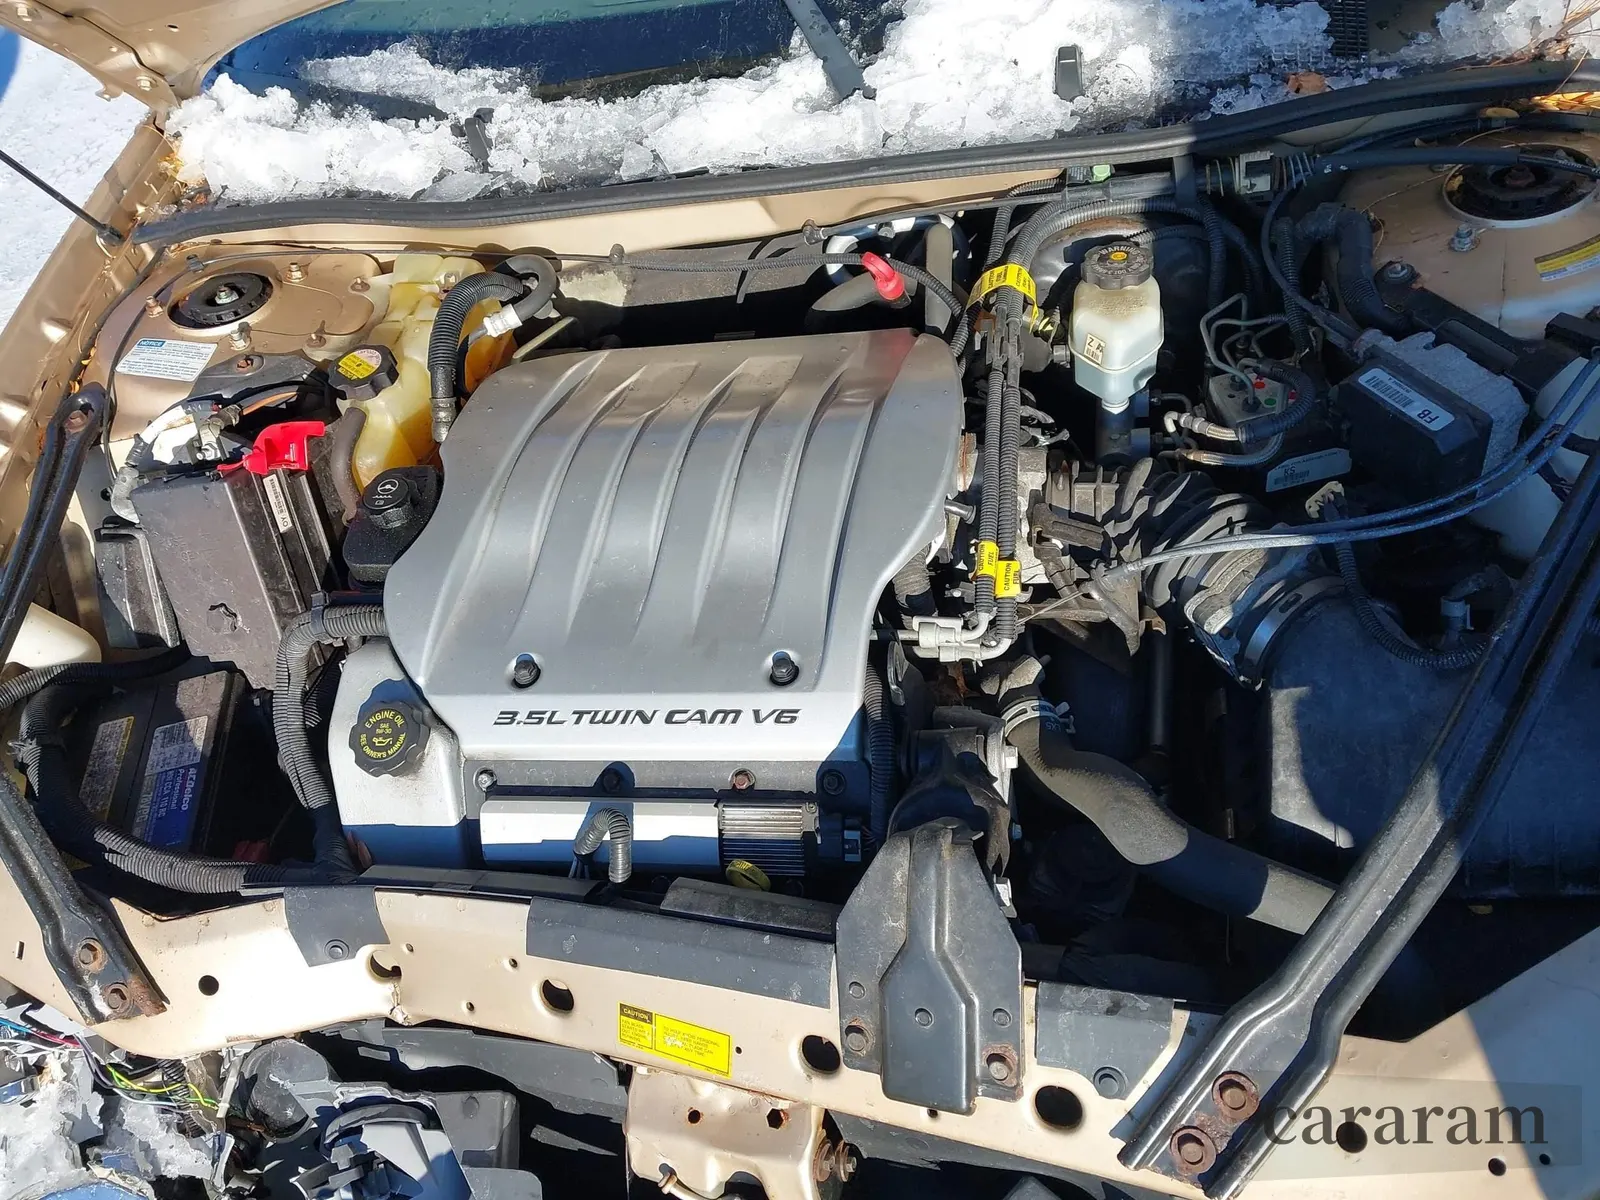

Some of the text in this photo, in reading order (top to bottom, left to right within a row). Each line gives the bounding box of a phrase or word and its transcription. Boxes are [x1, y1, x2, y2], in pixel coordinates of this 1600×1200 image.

[1098, 245, 1140, 255] WARNING
[1417, 409, 1439, 424] FB
[280, 516, 288, 527] OY
[1003, 563, 1012, 591] CAUTION
[1012, 570, 1020, 584] FUEL
[365, 710, 405, 729] ENGINE OIL
[493, 708, 802, 726] 3.5L TWIN CAM V6
[362, 745, 387, 759] OWNER'S
[387, 732, 406, 756] MANUAL
[623, 1008, 649, 1020] CAUTION
